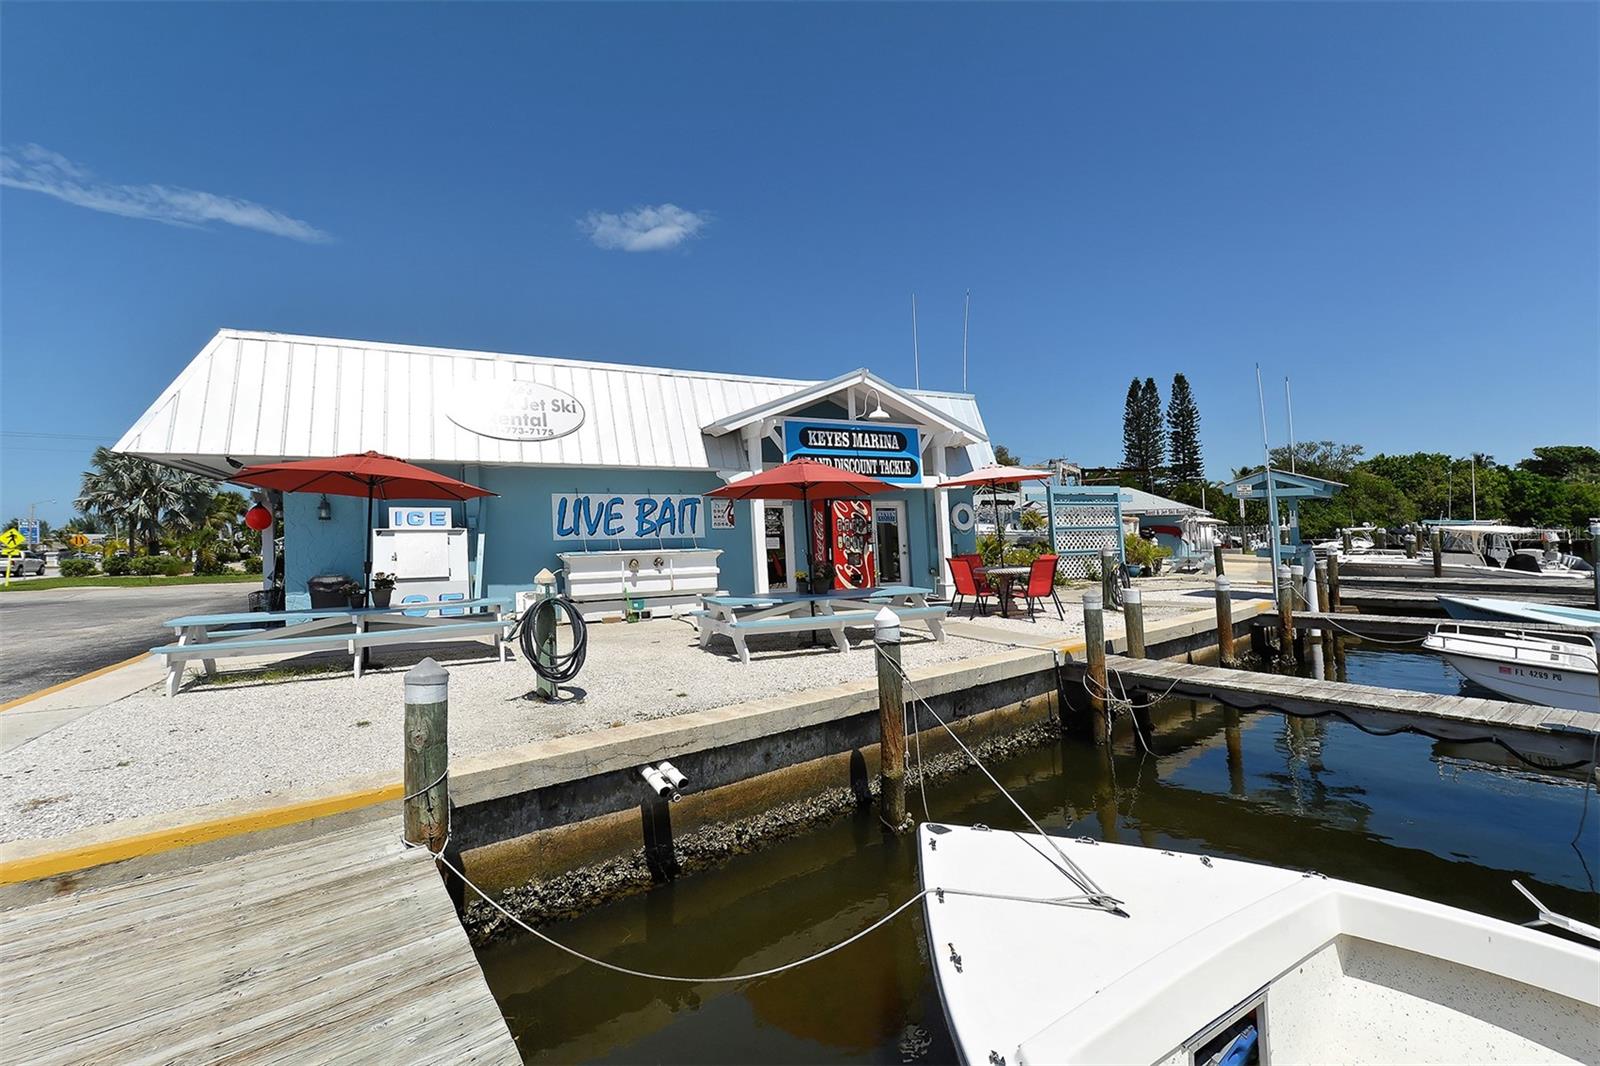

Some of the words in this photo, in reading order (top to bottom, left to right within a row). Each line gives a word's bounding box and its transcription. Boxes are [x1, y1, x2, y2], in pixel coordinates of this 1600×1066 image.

[551, 398, 578, 414] Ski
[493, 412, 548, 428] ental
[807, 430, 850, 448] KEYES
[852, 432, 900, 450] MARINA
[833, 458, 878, 475] DISCOUNT
[879, 460, 912, 475] TACKLE
[394, 511, 447, 527] ICE
[556, 495, 625, 537] LIVE
[634, 497, 701, 538] BAIT
[401, 593, 465, 618] CE
[1514, 668, 1525, 677] FL
